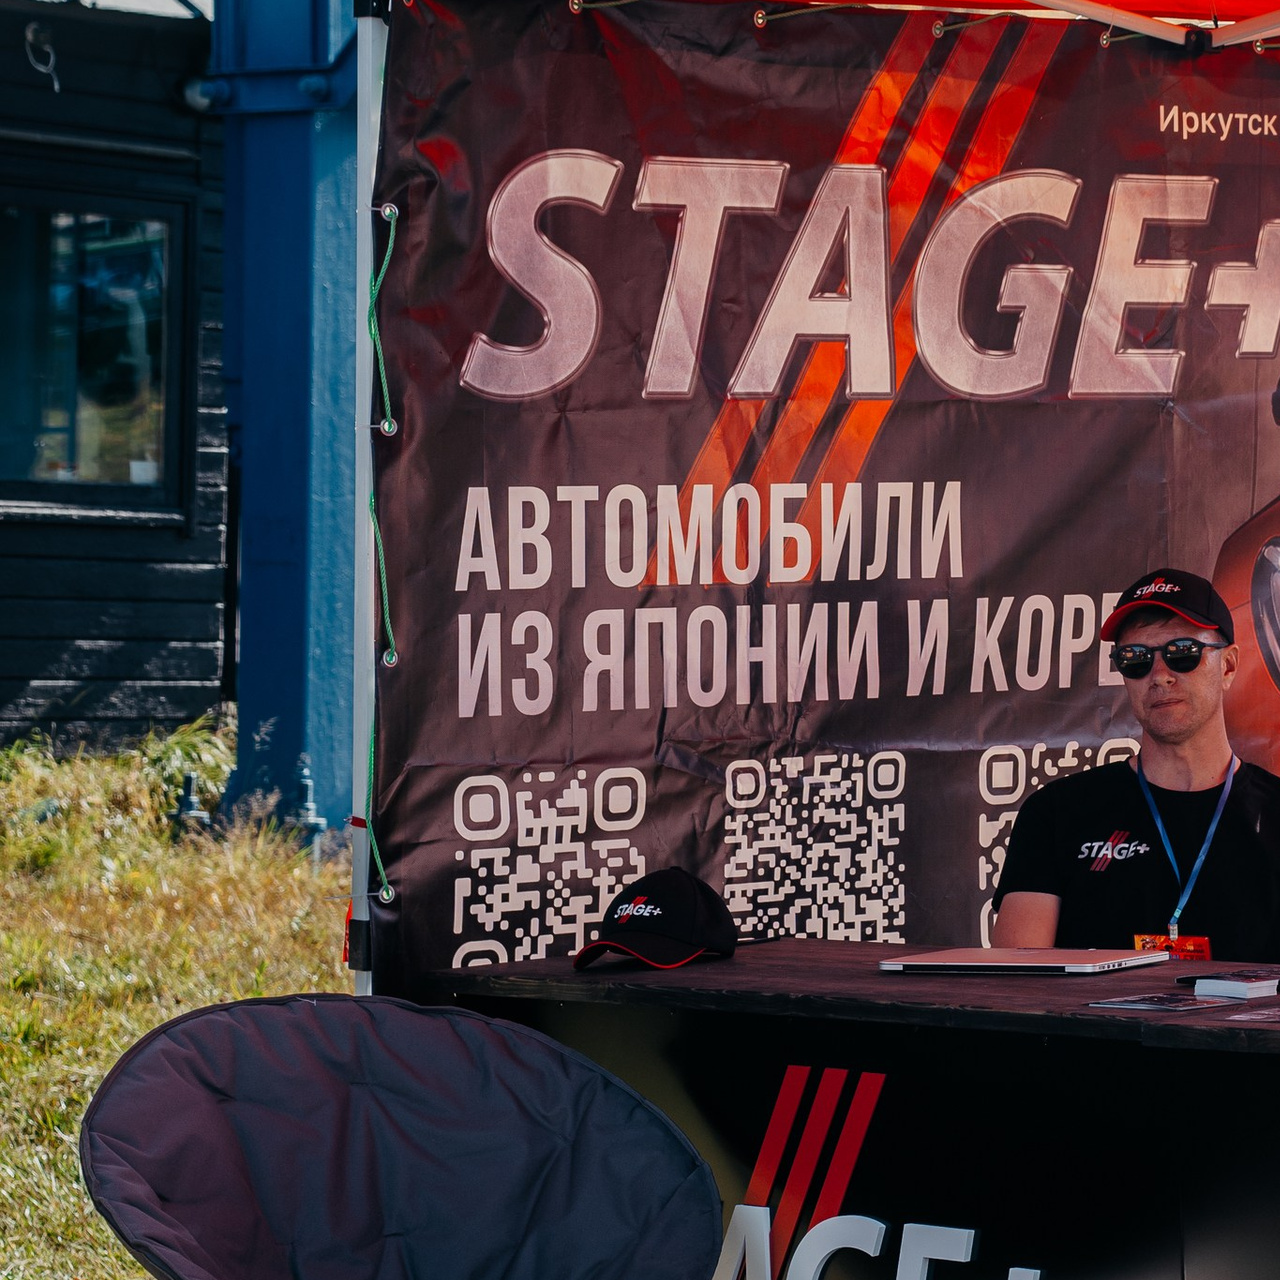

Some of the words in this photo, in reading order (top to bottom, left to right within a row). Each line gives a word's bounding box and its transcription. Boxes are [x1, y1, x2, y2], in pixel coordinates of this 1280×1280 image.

[1158, 105, 1278, 142] Иркутск
[455, 481, 964, 592] АВТОМОБИЛИ
[1134, 582, 1181, 598] STAGE+
[457, 611, 554, 718] ИЗ
[581, 601, 880, 711] ЯПОНИИ
[906, 599, 948, 698] И
[1078, 840, 1150, 860] STAGE+
[613, 903, 662, 919] STAGE+
